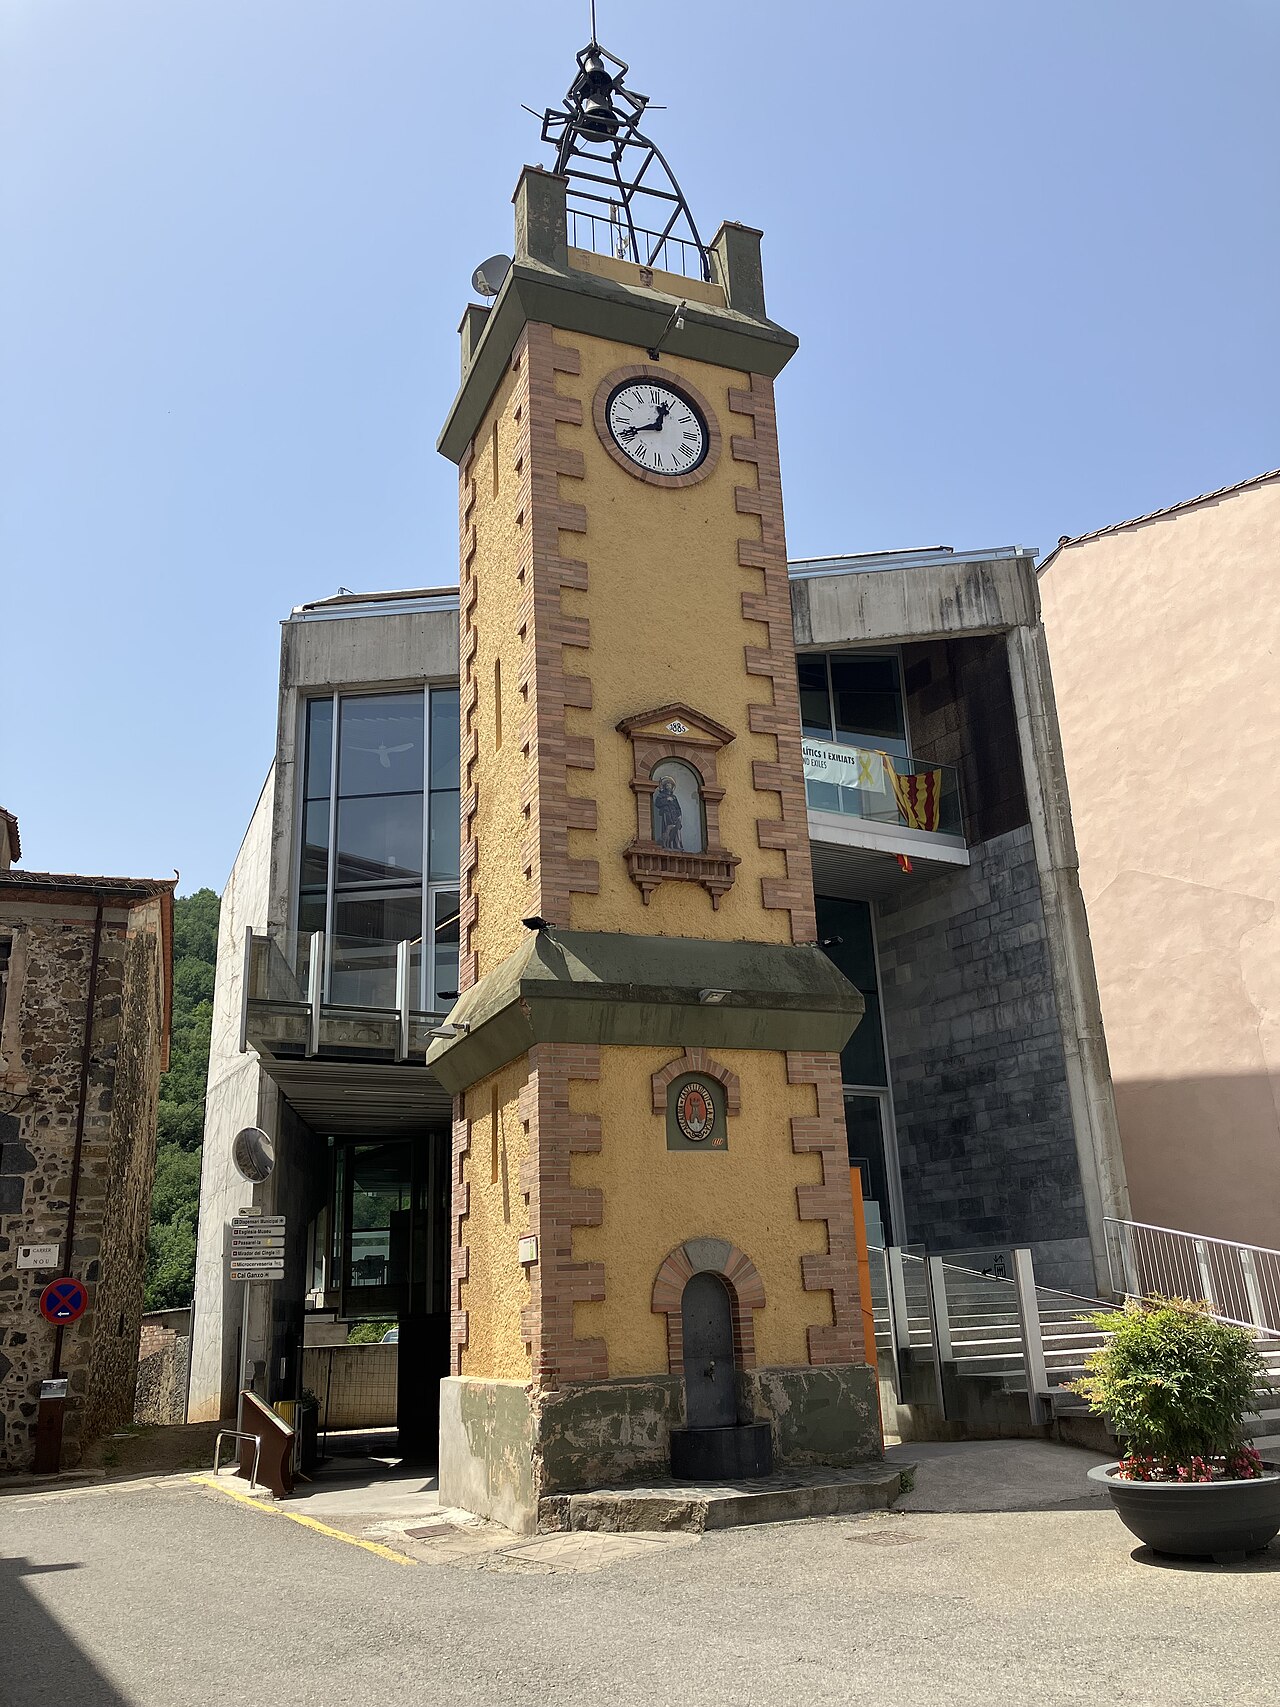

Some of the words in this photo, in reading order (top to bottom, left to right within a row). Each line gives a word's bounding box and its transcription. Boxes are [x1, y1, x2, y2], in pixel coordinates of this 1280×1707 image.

[620, 400, 634, 412] X
[670, 723, 686, 732] 1885
[811, 758, 828, 769] EXILES
[828, 752, 855, 765] EXILIATS
